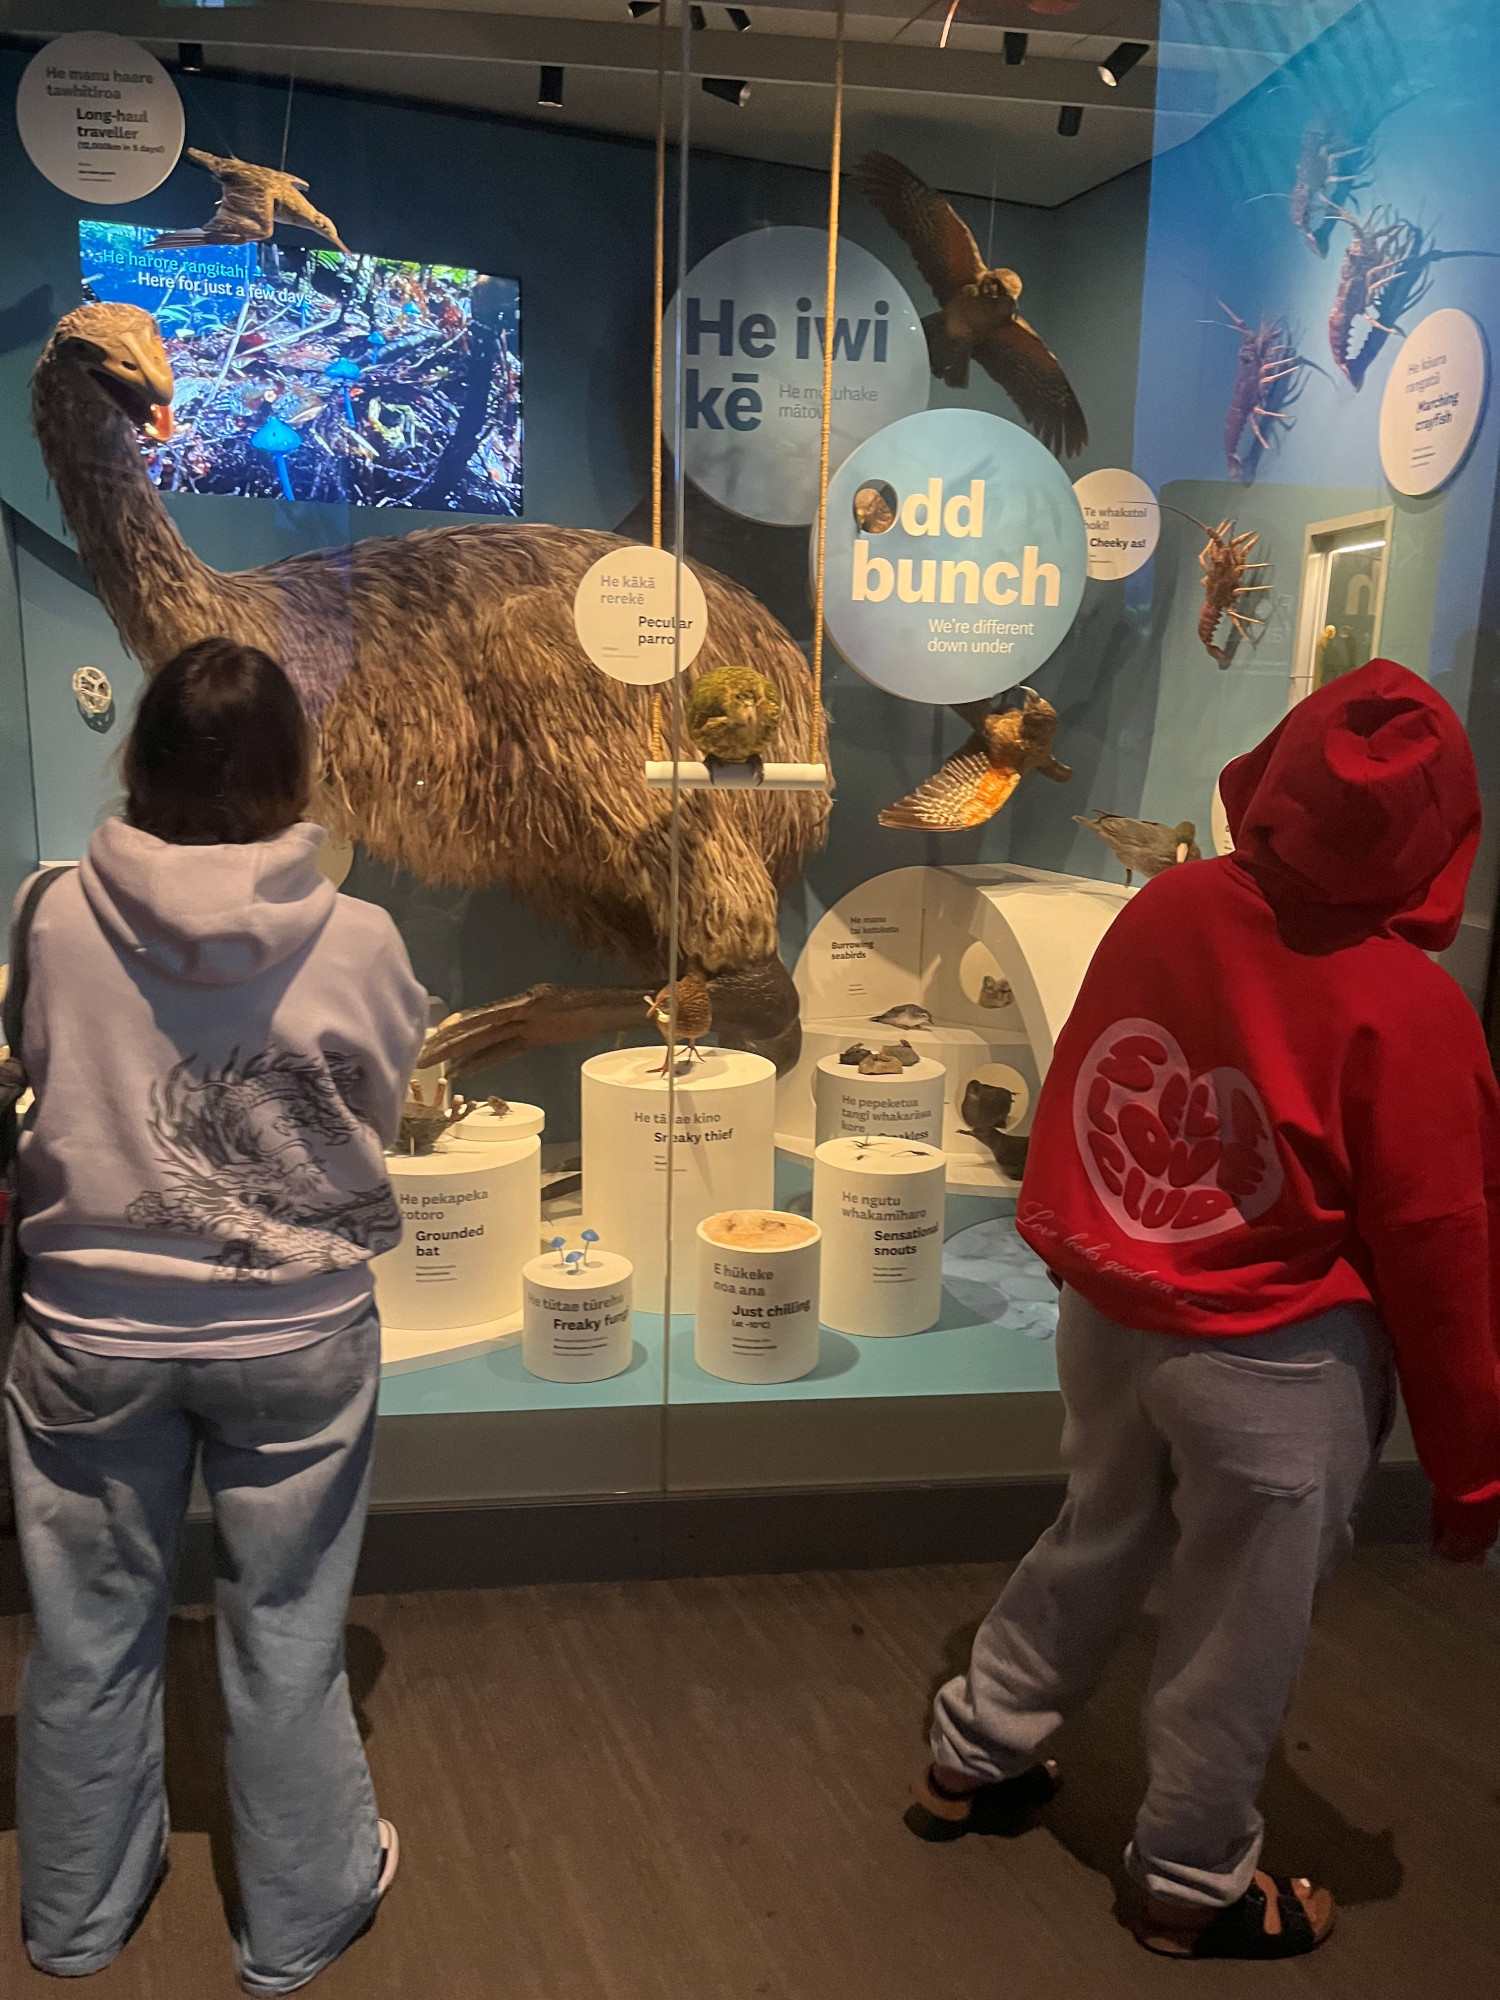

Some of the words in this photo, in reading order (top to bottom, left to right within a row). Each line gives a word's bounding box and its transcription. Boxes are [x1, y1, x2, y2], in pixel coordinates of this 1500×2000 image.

[46, 66, 66, 79] He
[113, 70, 154, 84] haere
[76, 107, 149, 124] Long-haul
[77, 126, 140, 139] traveller
[103, 249, 125, 264] He
[128, 252, 179, 270] harore
[182, 259, 249, 279] rangitahi
[137, 271, 175, 290] Here
[178, 275, 200, 291] for
[202, 277, 233, 296] just
[235, 283, 246, 297] a
[249, 283, 276, 299] few
[685, 297, 777, 359] He
[795, 296, 890, 362] iwi
[685, 368, 763, 431] kē
[779, 384, 800, 399] He
[803, 384, 879, 402] mouhake
[1414, 409, 1453, 432] crayfish
[1083, 506, 1096, 516] Te
[1090, 537, 1129, 550] Cheeky
[1130, 538, 1147, 548] as!
[851, 539, 1061, 607] bunch
[600, 575, 620, 587] He
[622, 575, 656, 589] kākā
[600, 592, 646, 606] rerekē
[638, 615, 694, 630] Pecular
[928, 618, 970, 634] We’re
[972, 619, 1035, 636] different
[637, 634, 676, 647] parro
[927, 636, 968, 653] down
[971, 638, 1015, 654] under
[831, 940, 875, 950] Burrowing
[831, 950, 867, 960] seabirds
[843, 1094, 857, 1106] He
[859, 1098, 919, 1110] pepeketua
[635, 1111, 650, 1123] He
[654, 1113, 691, 1125] tāae
[694, 1112, 721, 1124] kino
[841, 1108, 870, 1122] tangi
[704, 1127, 734, 1142] thief
[401, 1192, 418, 1205] He
[421, 1189, 489, 1208] pekapeka
[842, 1190, 859, 1204] He
[861, 1195, 901, 1208] ngutu
[841, 1207, 927, 1221] whakamīharo
[1017, 1201, 1058, 1237] Love
[415, 1224, 485, 1242] Grounded
[873, 1220, 940, 1241] Sensational
[415, 1244, 441, 1257] bat
[873, 1244, 917, 1256] snouts
[714, 1263, 722, 1275] E
[723, 1264, 775, 1281] hūkeke
[714, 1280, 736, 1295] noa
[738, 1284, 766, 1297] ana
[542, 1298, 580, 1312] tūtae
[732, 1304, 764, 1317] Just
[766, 1300, 811, 1317] chilling
[553, 1318, 601, 1332] Freaky
